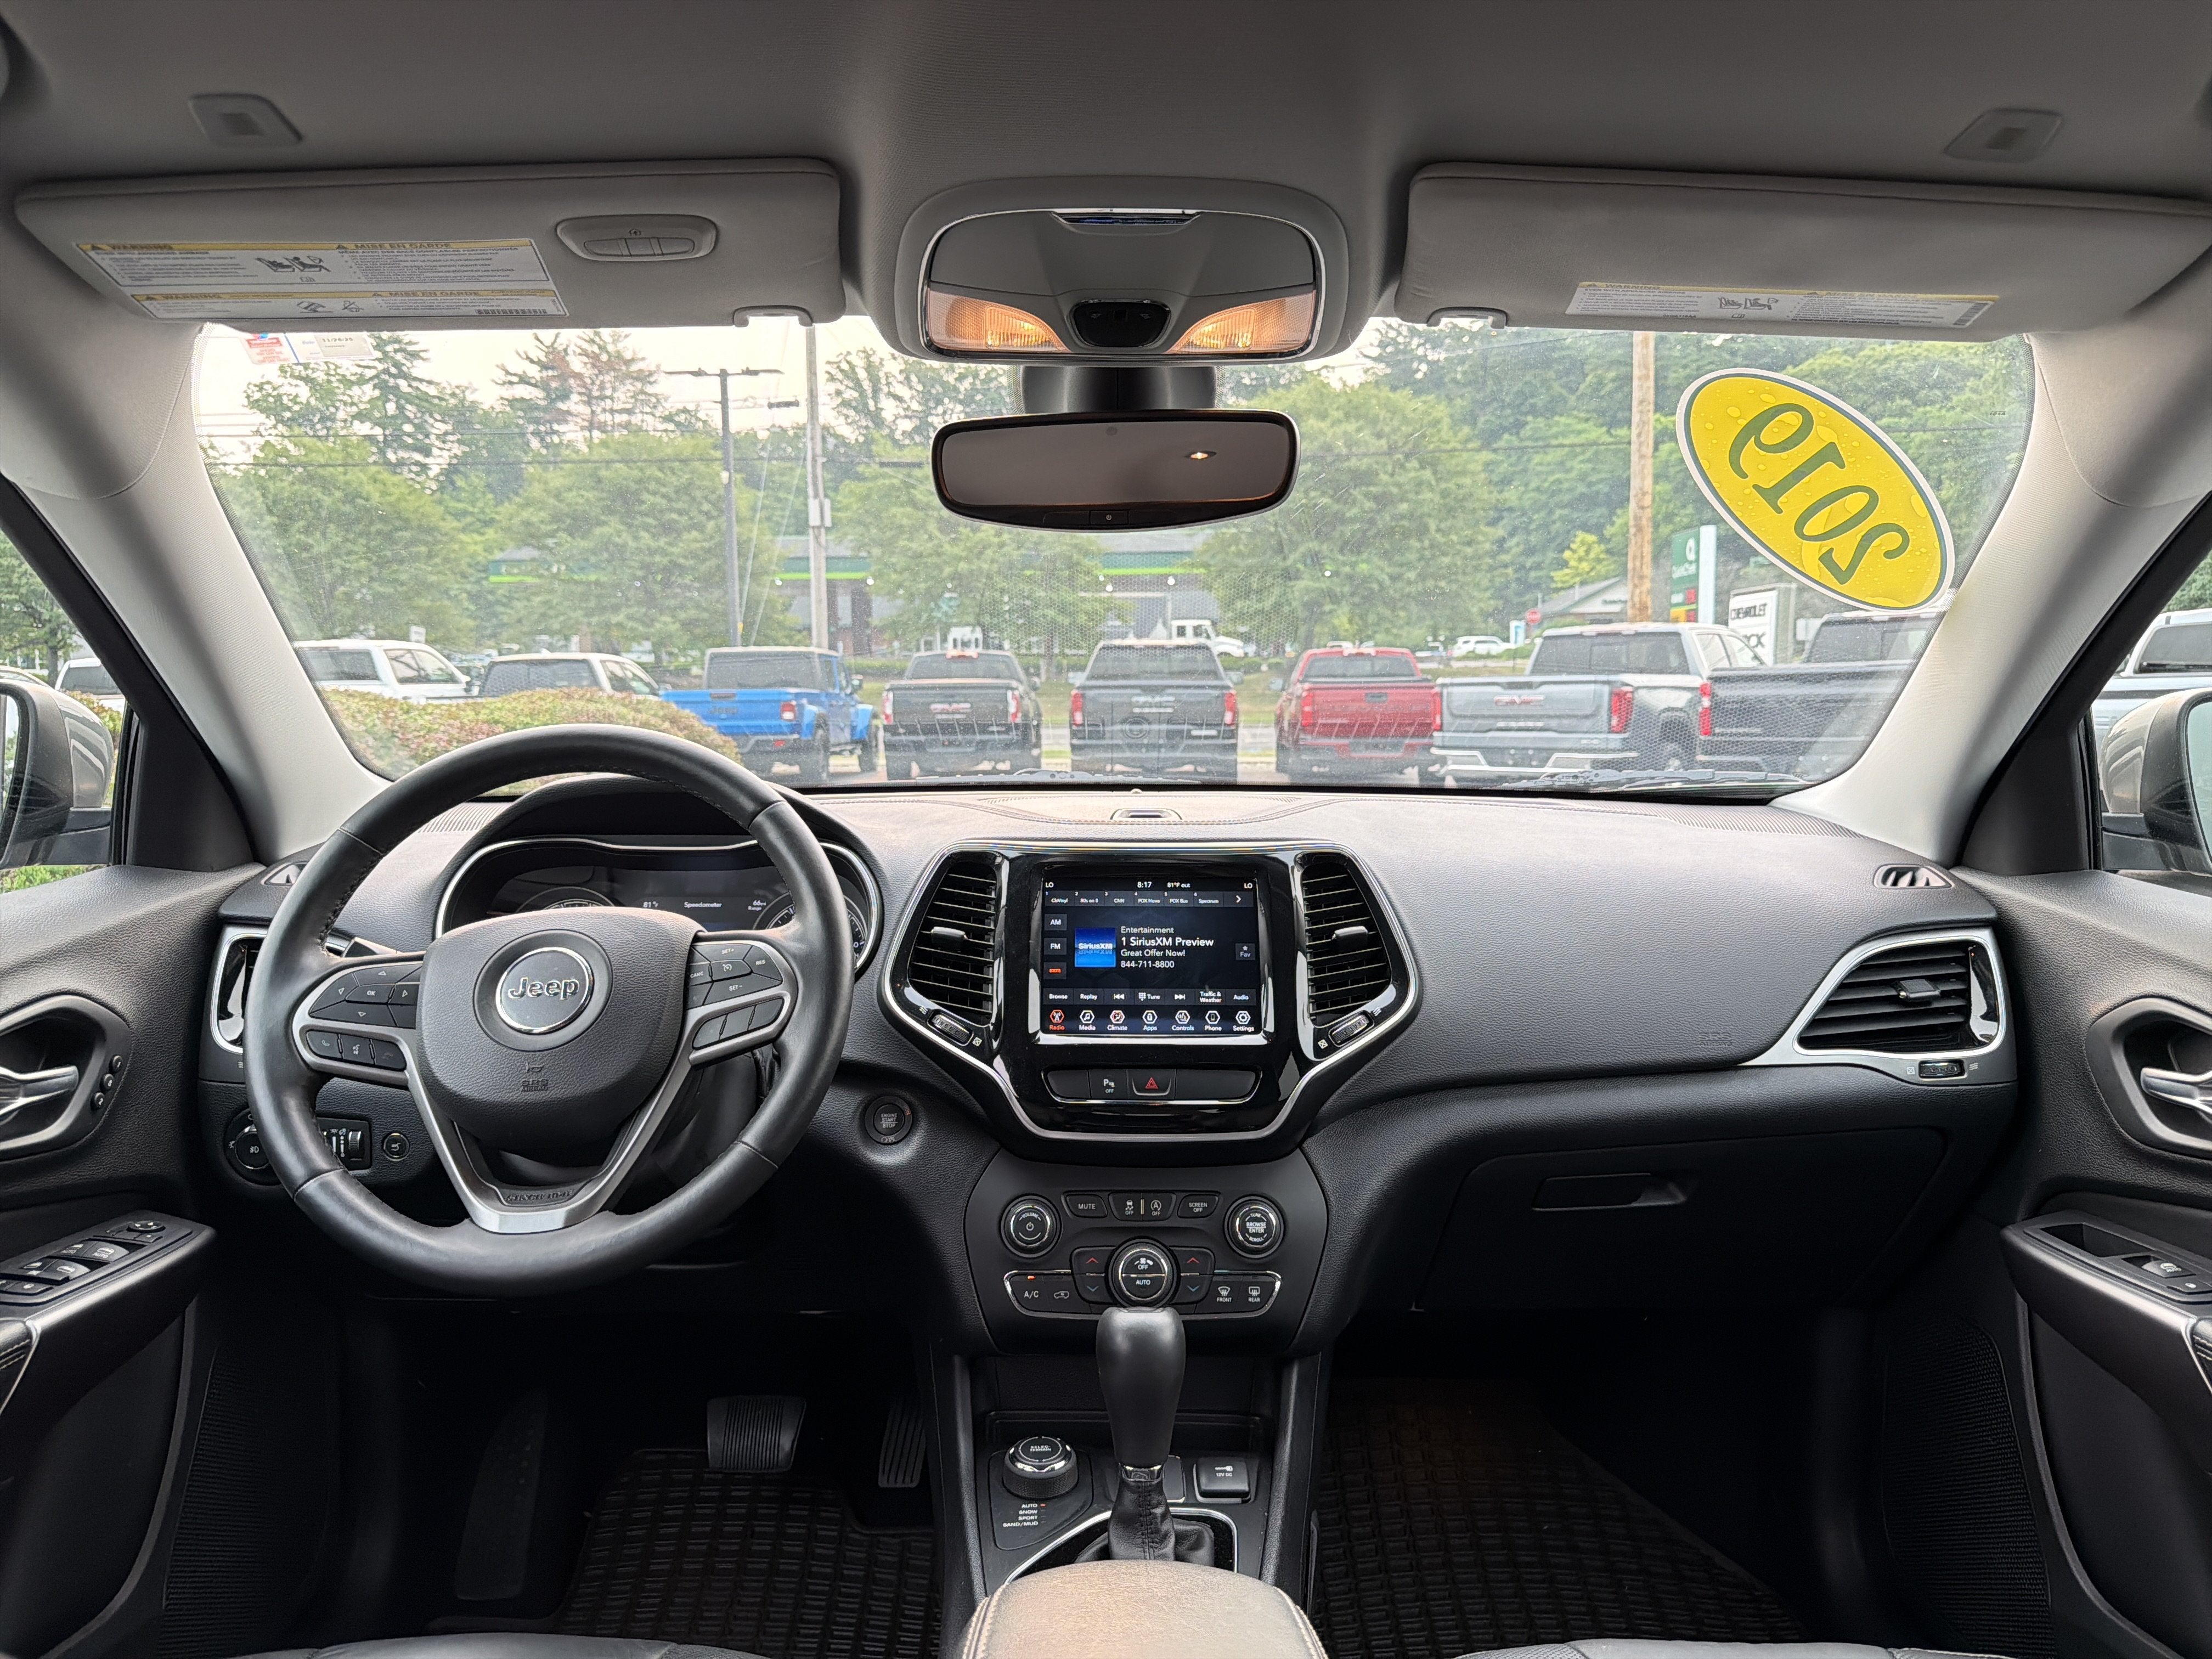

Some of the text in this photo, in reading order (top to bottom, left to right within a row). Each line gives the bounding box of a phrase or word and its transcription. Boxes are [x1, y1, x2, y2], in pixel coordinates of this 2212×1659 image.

[1494, 695, 1545, 707] GMC
[1121, 936, 1214, 946] 1 SiriusXM Preview
[507, 977, 580, 1000] Jeep
